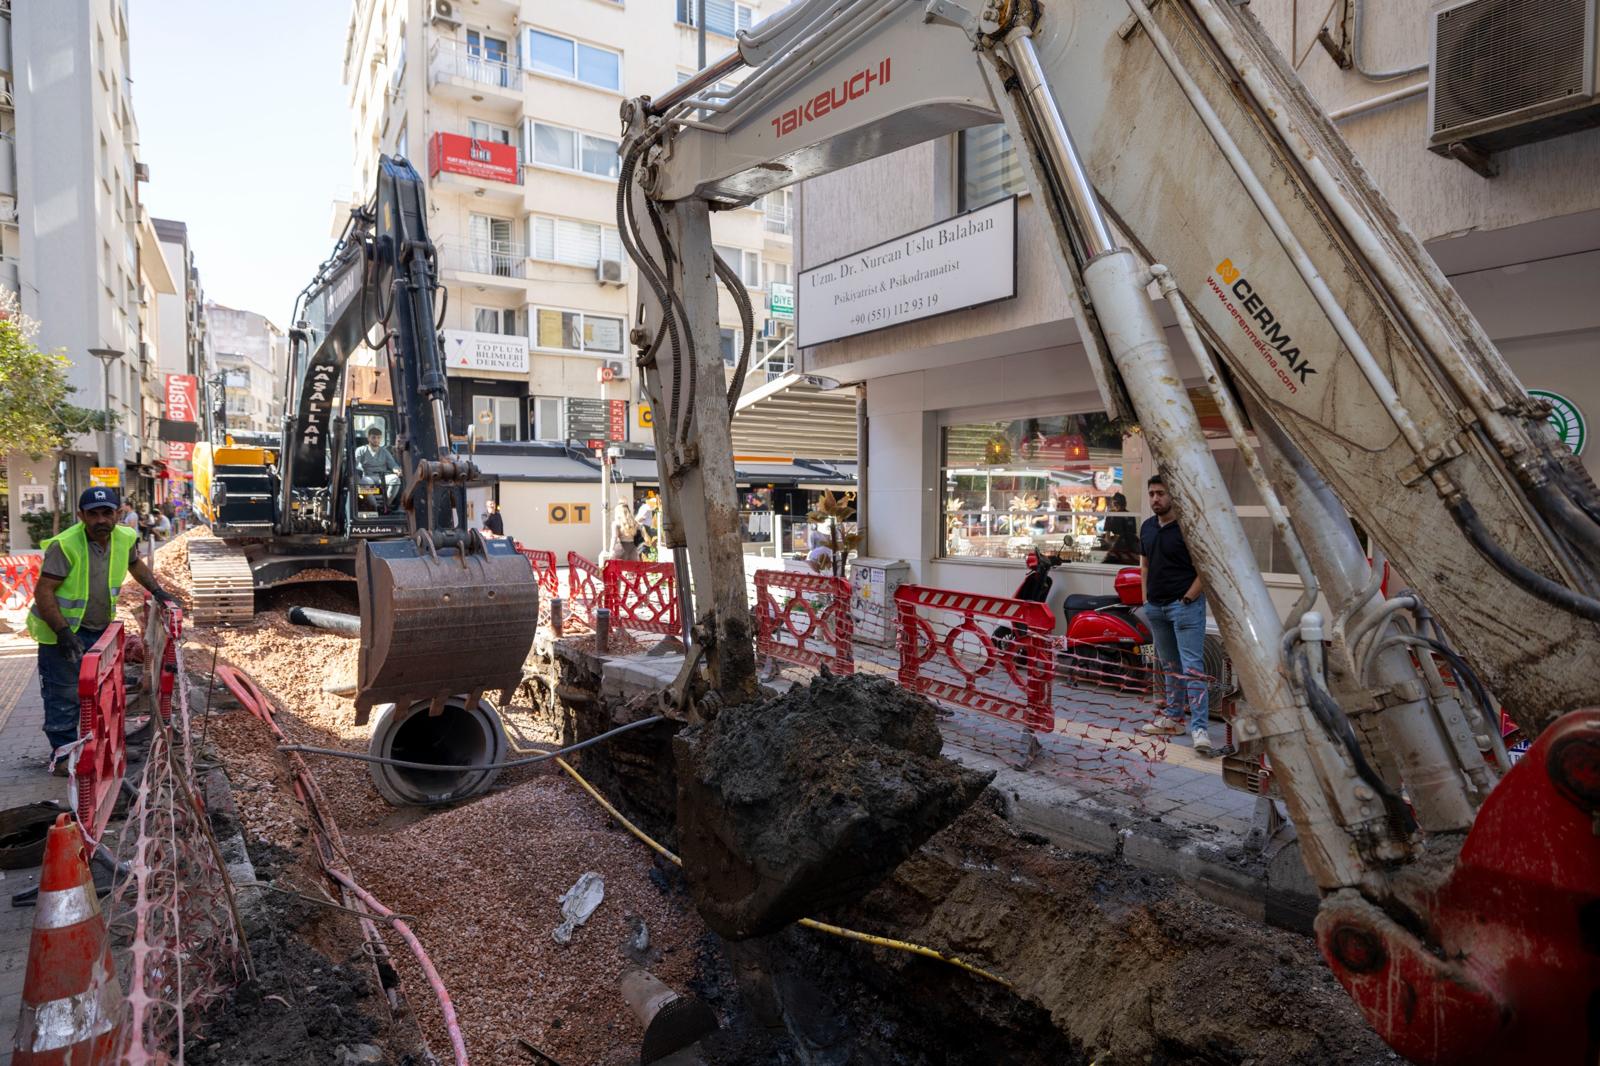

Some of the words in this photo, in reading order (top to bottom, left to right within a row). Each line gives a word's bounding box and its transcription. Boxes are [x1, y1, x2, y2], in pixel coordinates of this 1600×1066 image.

[771, 57, 891, 138] TAKEUCHI
[811, 272, 837, 288] Uzm.
[840, 264, 857, 278] Dr.
[860, 249, 902, 271] Nurcan
[905, 237, 934, 256] Uslu
[938, 216, 994, 246] Balaban
[834, 283, 878, 306] Psikiyatrist
[880, 281, 887, 292] &
[889, 259, 960, 290] Psikodramatist
[850, 312, 866, 326] +90
[867, 307, 891, 324] (551)
[893, 300, 910, 316] 112
[911, 297, 924, 311] 93
[927, 293, 939, 306] 19
[1206, 275, 1298, 394] www.cerenmakina.com
[1231, 278, 1318, 385] CERMAK
[476, 344, 524, 354] TOPLUM
